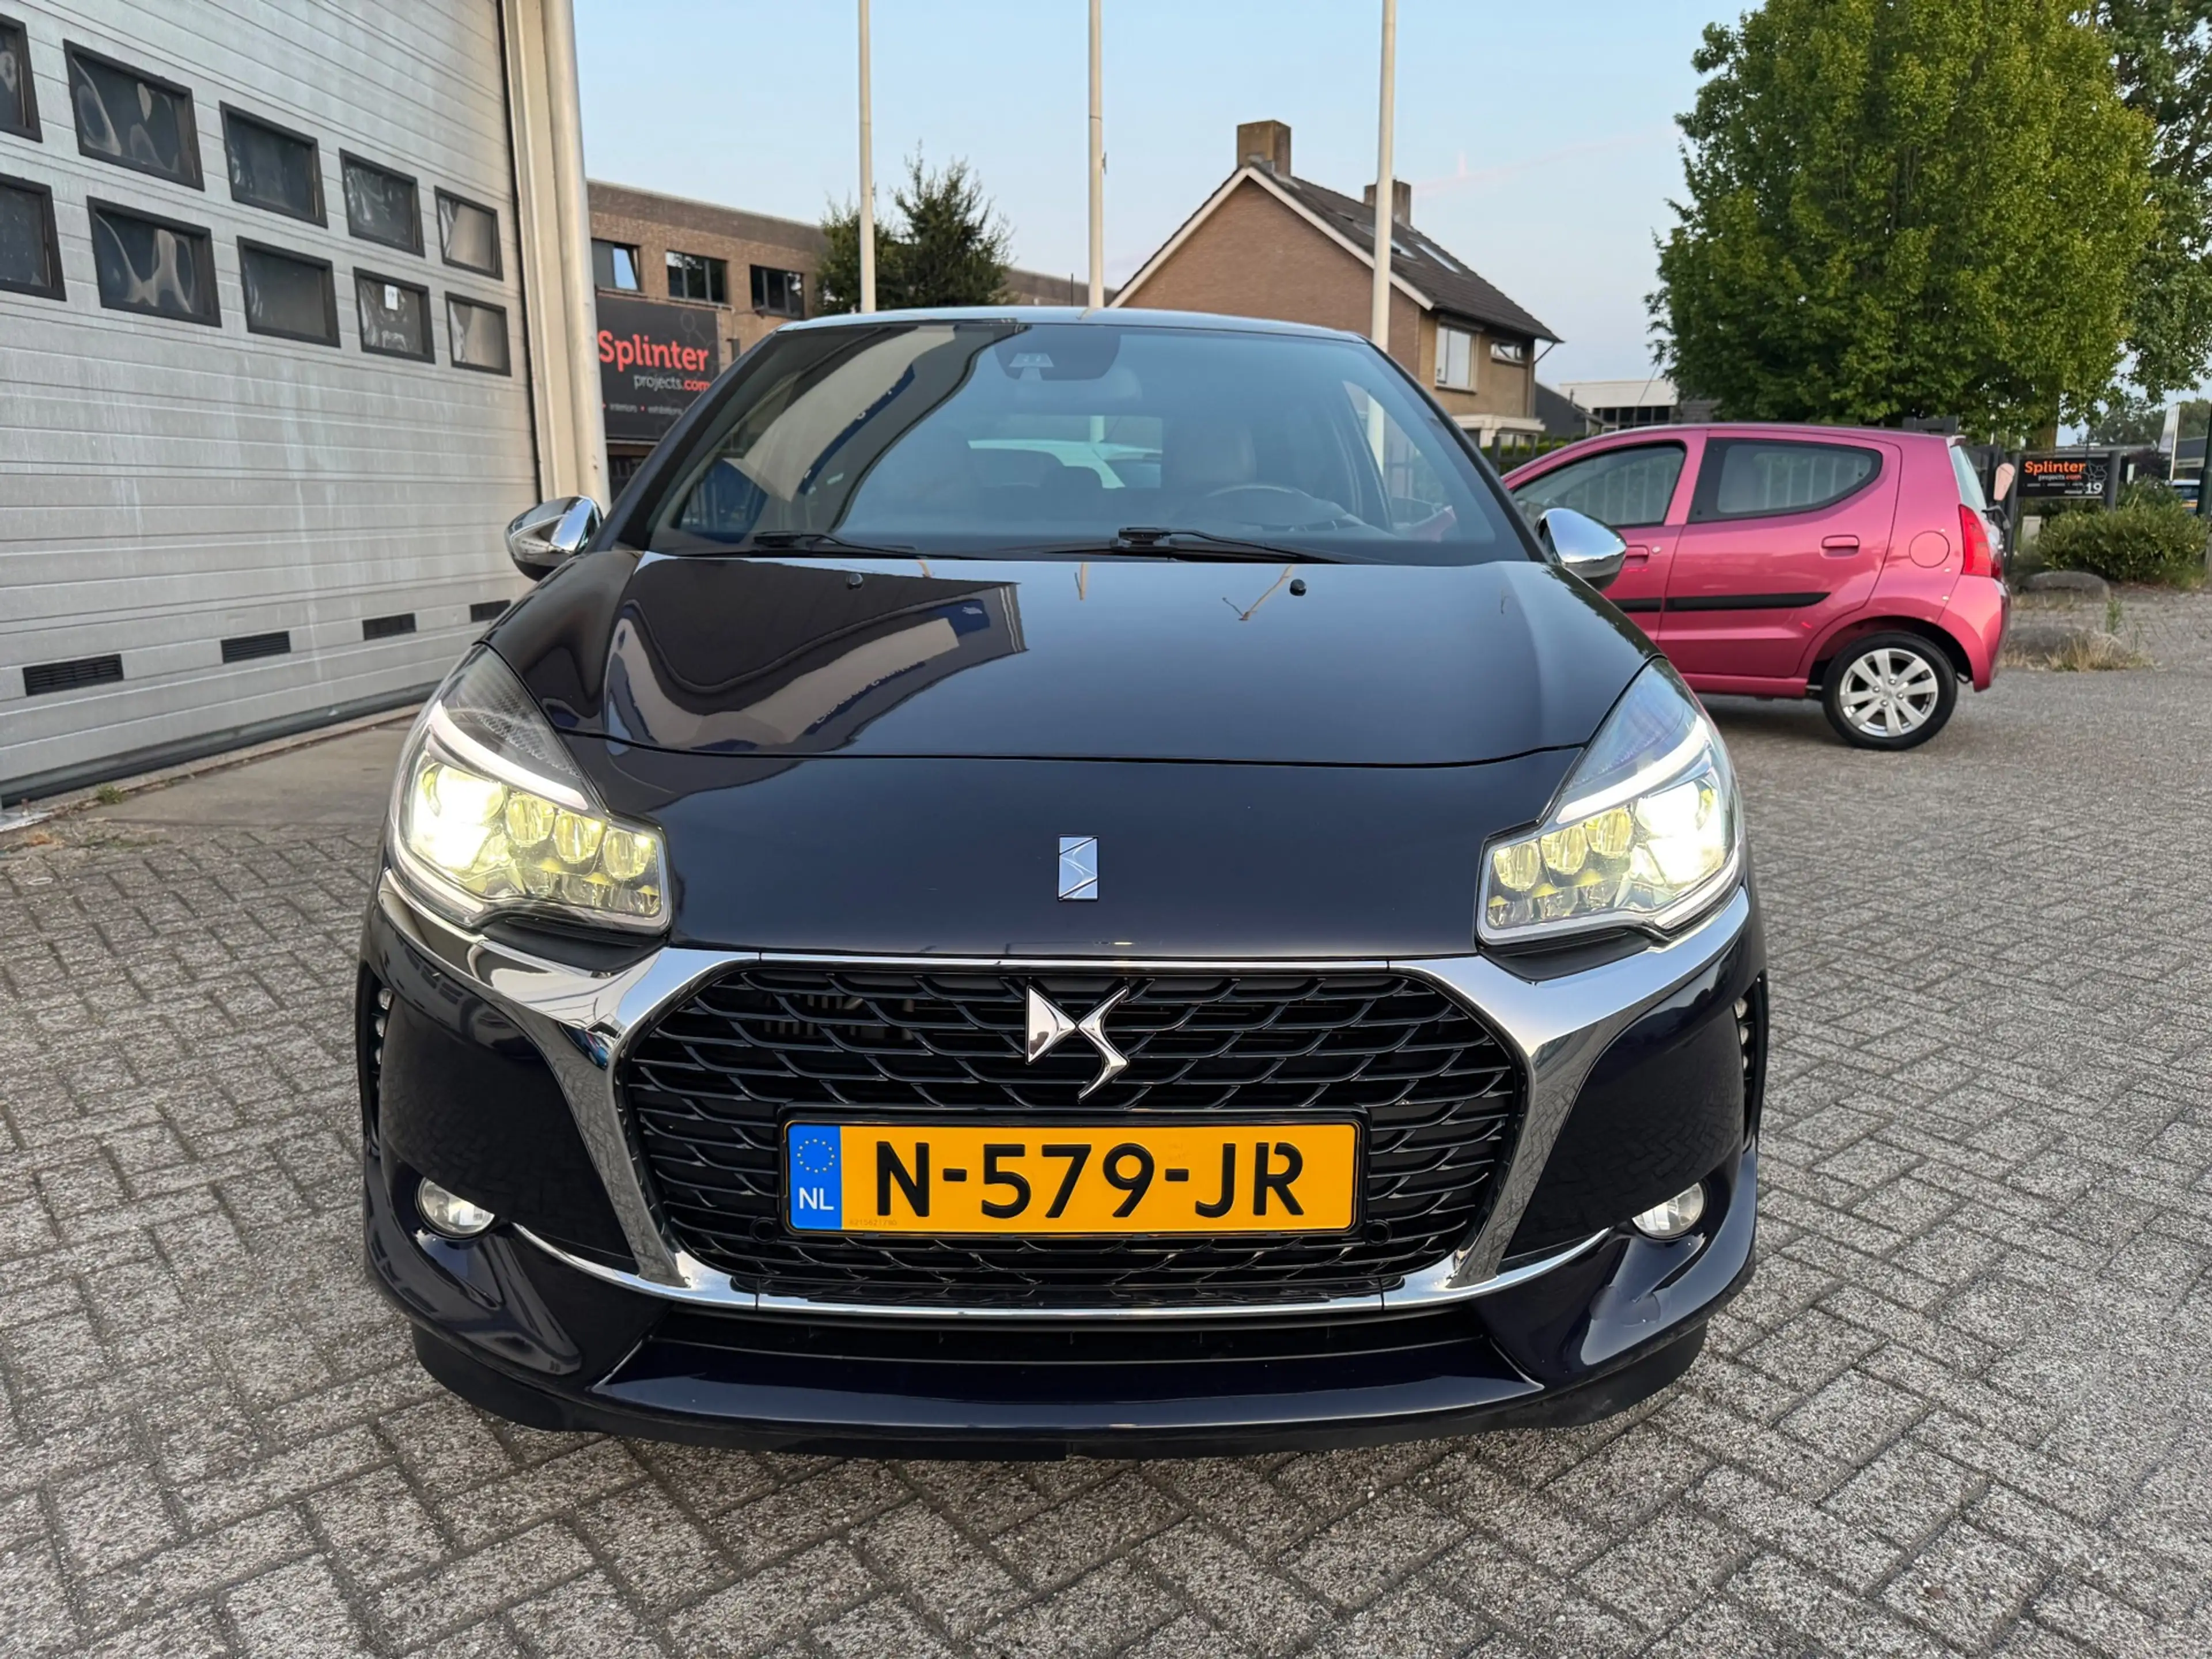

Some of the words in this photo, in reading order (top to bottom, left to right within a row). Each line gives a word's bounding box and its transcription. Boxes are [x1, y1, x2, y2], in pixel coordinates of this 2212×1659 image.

[598, 329, 709, 372] Splinter
[634, 374, 711, 392] projects.com
[2024, 460, 2087, 476] Splinter
[2085, 482, 2103, 494] 19
[876, 1141, 1305, 1219] N-579-JR
[799, 1187, 835, 1210] NL
